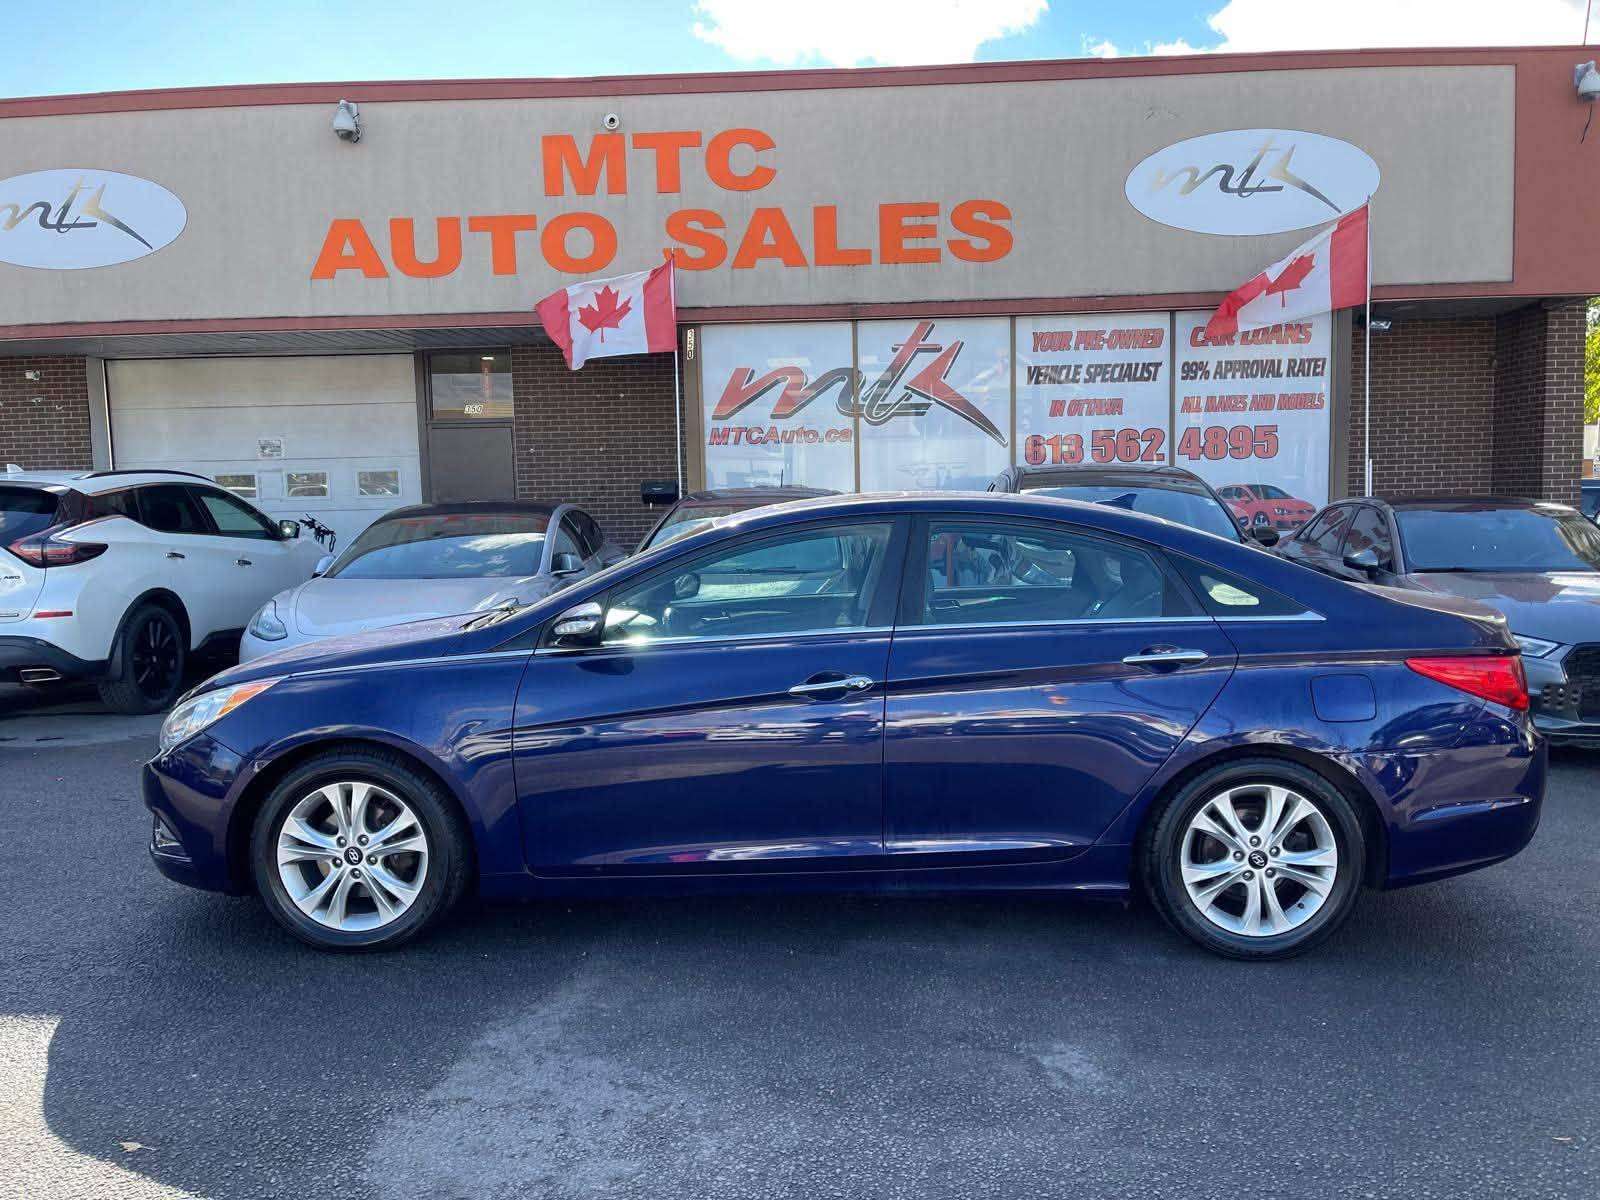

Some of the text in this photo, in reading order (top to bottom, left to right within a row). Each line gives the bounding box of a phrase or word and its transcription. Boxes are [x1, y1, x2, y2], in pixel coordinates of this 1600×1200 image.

[541, 128, 777, 197] MTC
[311, 200, 1014, 280] AUTO SALES
[1032, 328, 1164, 352] YOUR PRE-OWNED
[1240, 322, 1313, 346] LOANS
[1026, 361, 1163, 385] VEHICLE SPECIALIST
[1181, 357, 1327, 381] 99% APPROVAL RATE!
[1049, 398, 1124, 417] IN OTTAWA
[1181, 392, 1325, 414] ALL MAKES AND MODELS
[709, 426, 852, 446] MTCAuto.ca
[1025, 424, 1279, 465] 613 562 4895
